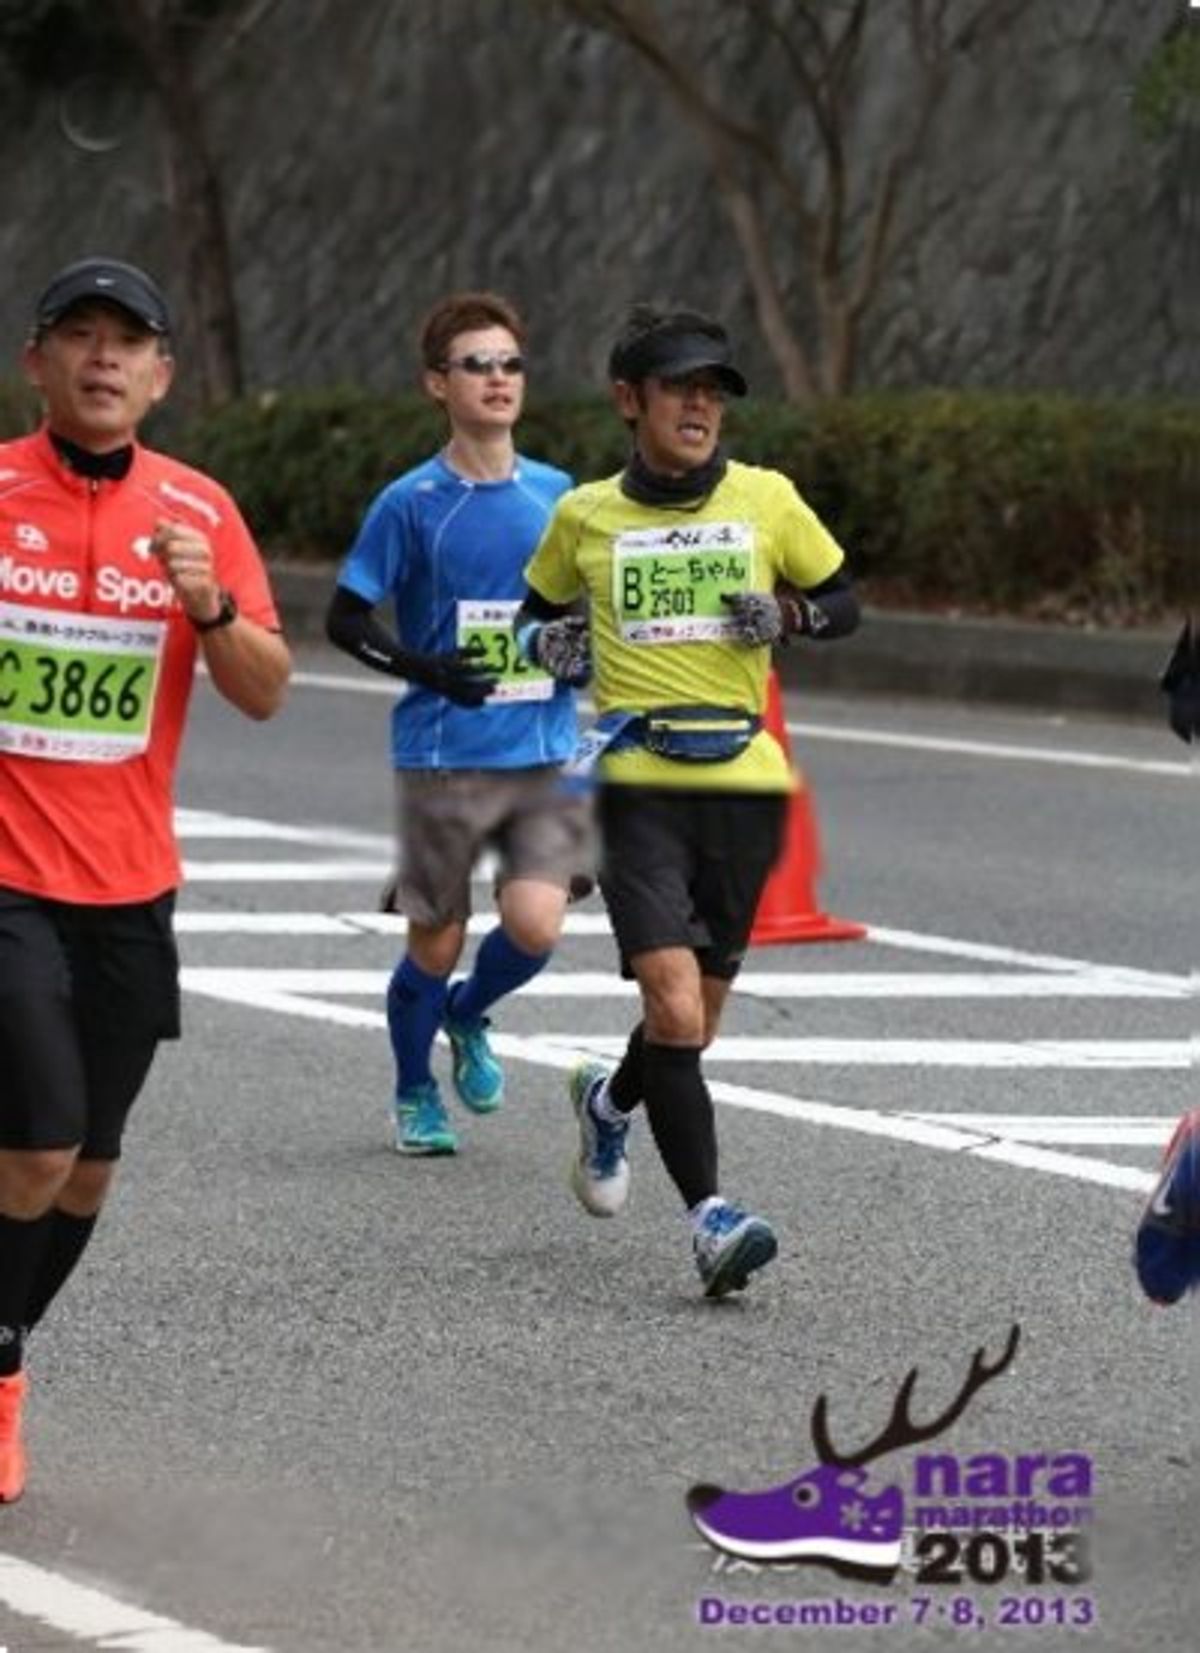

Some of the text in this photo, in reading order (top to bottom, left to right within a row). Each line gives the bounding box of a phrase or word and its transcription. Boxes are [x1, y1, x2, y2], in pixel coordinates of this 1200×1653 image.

[623, 566, 644, 611] B
[650, 556, 746, 584] とーちゃん
[29, 656, 145, 721] 3866
